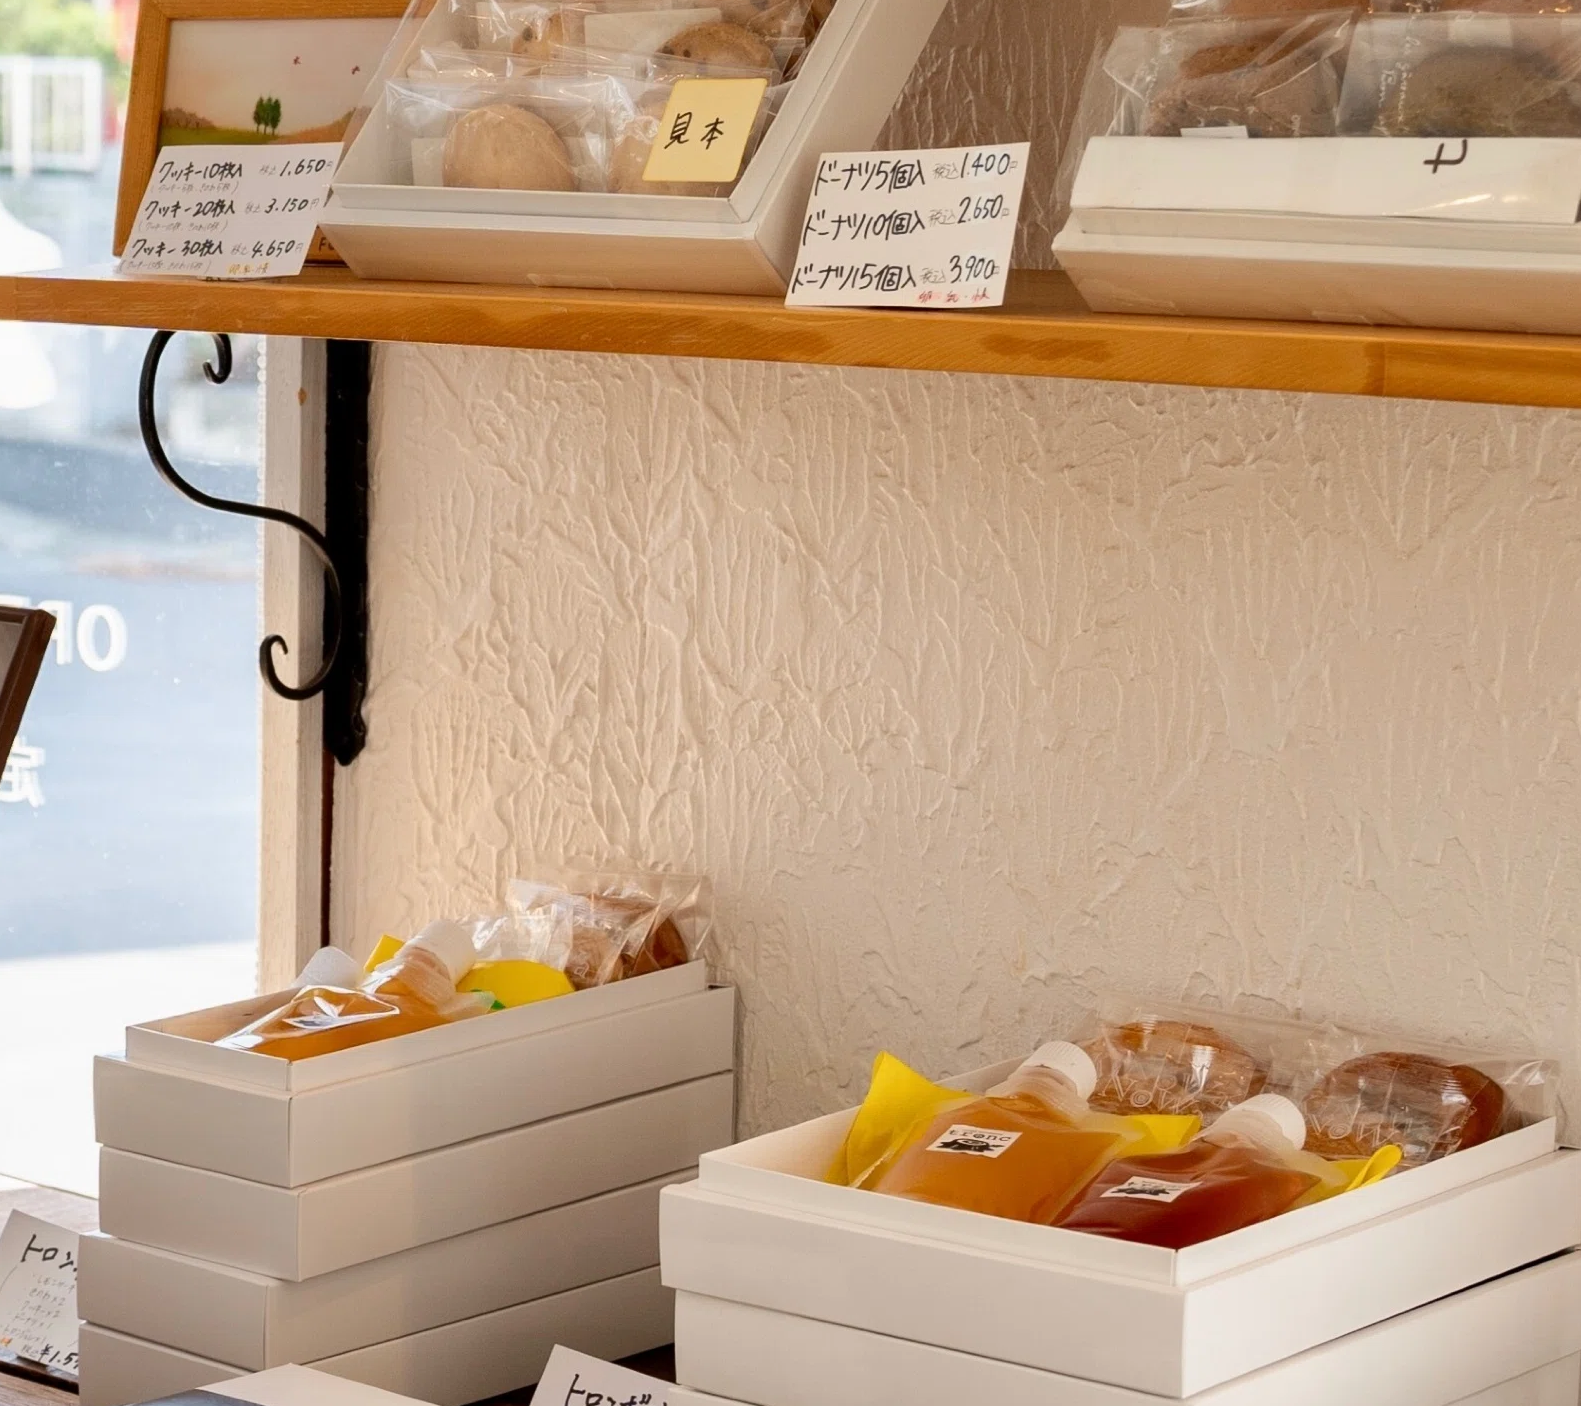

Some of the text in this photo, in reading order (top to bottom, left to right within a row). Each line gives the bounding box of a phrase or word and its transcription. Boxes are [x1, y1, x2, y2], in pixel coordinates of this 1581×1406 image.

[664, 111, 724, 150] 見本
[816, 159, 925, 196] ドーナツ5個入
[803, 208, 925, 245] ドーナツ10個入
[790, 262, 917, 294] ドーナツ15個入
[949, 1129, 1012, 1143] tronc
